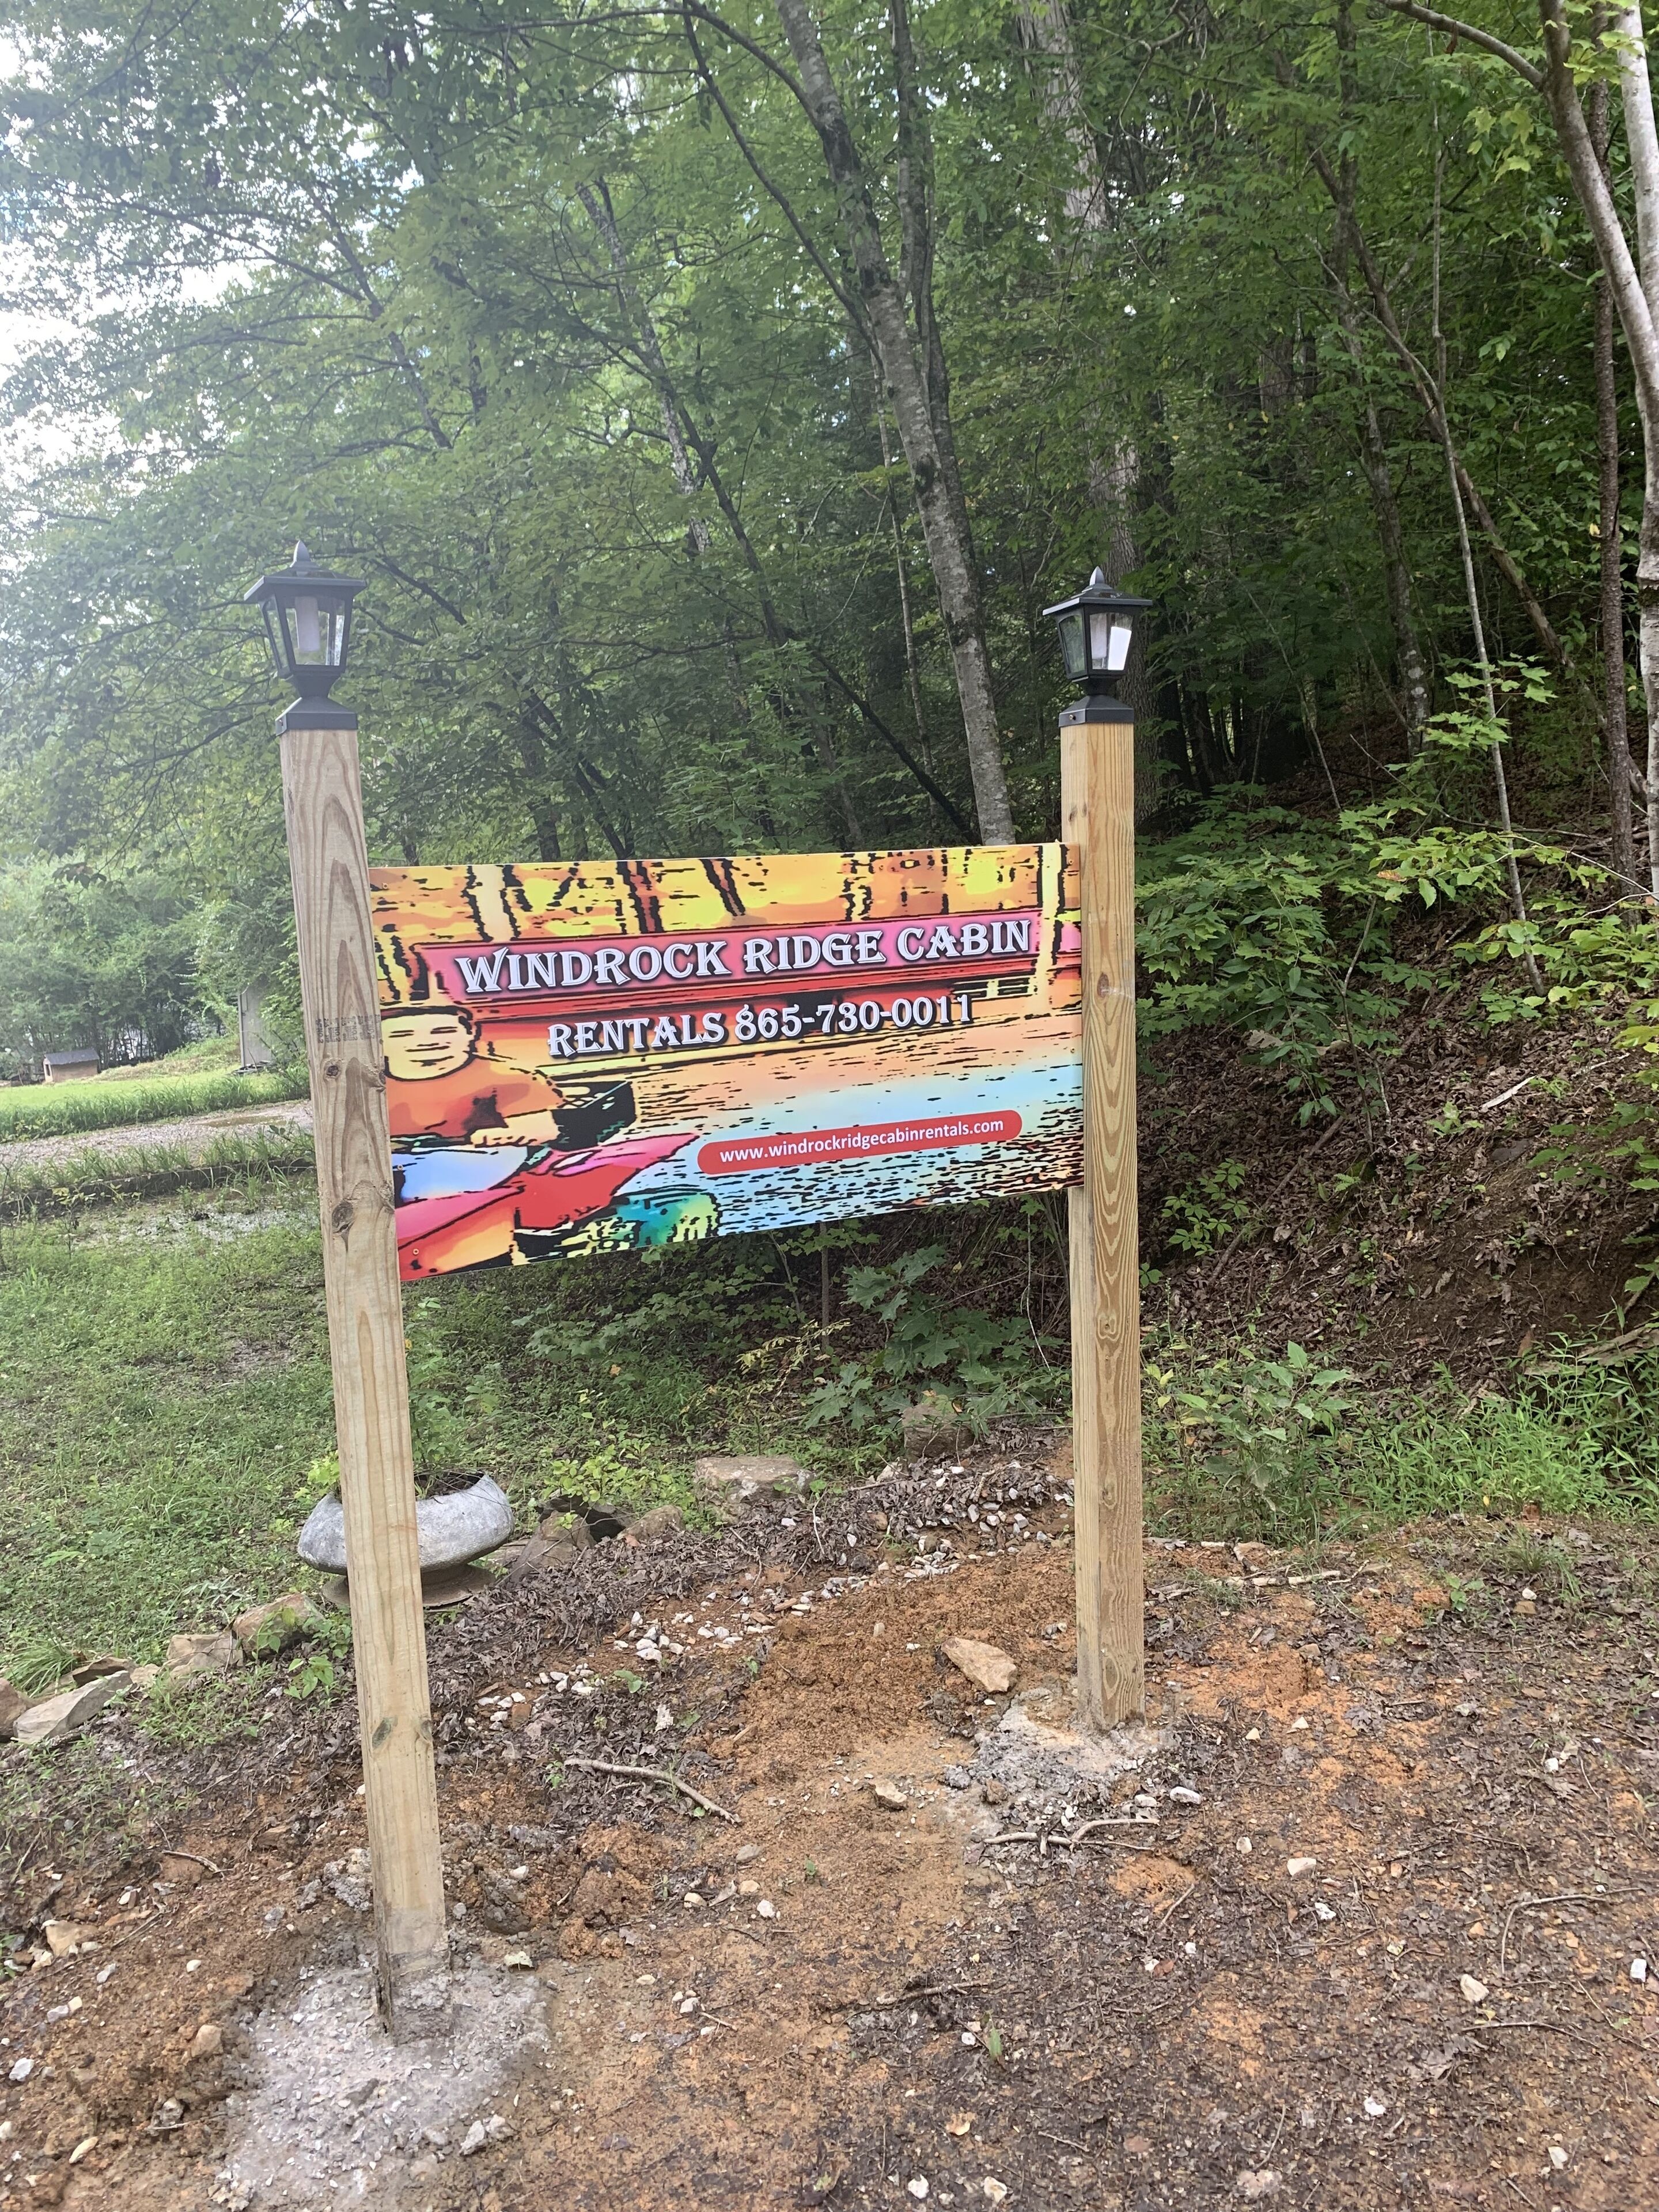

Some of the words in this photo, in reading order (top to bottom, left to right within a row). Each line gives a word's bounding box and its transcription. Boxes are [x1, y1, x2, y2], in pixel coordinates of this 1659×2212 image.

[454, 941, 732, 993] WINDROCK
[743, 930, 887, 974] RIDGE
[897, 920, 1031, 960] CABIN
[547, 1012, 725, 1057] RENTALS
[734, 994, 972, 1041] 865-730-0011
[719, 1118, 1003, 1162] www.windrockridgecabinrentals.com
